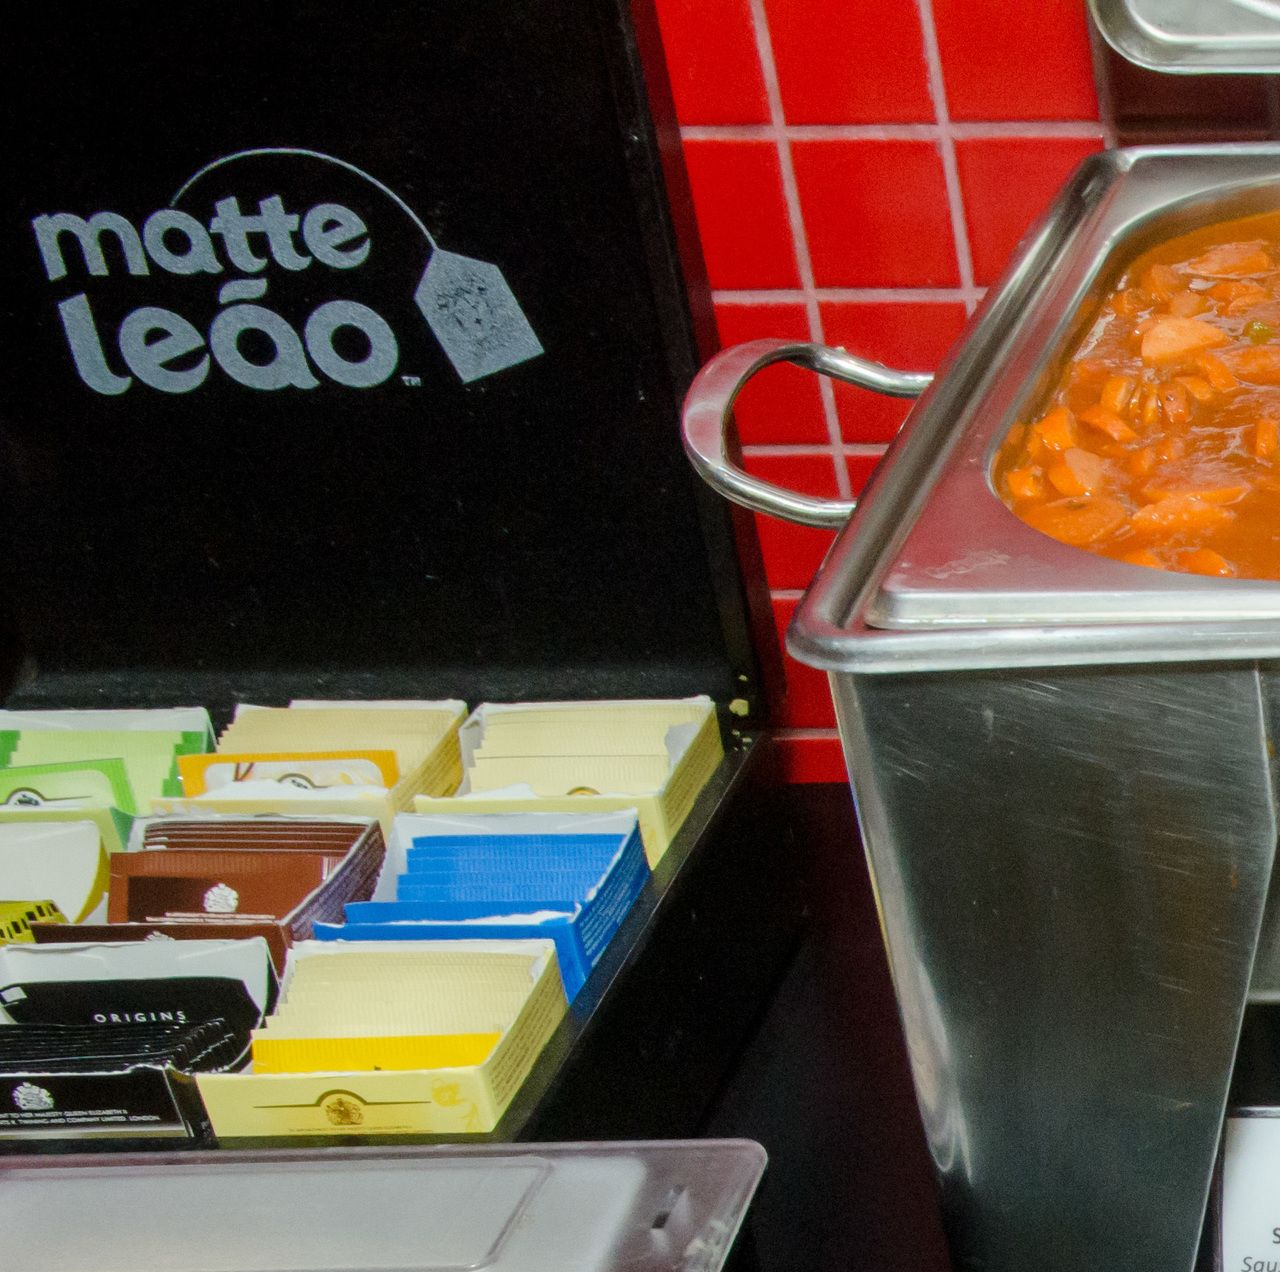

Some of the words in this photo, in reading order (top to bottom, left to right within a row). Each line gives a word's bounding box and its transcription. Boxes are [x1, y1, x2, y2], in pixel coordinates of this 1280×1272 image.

[32, 195, 371, 281] matte
[58, 278, 399, 395] leão
[94, 1011, 186, 1023] ORIGINS
